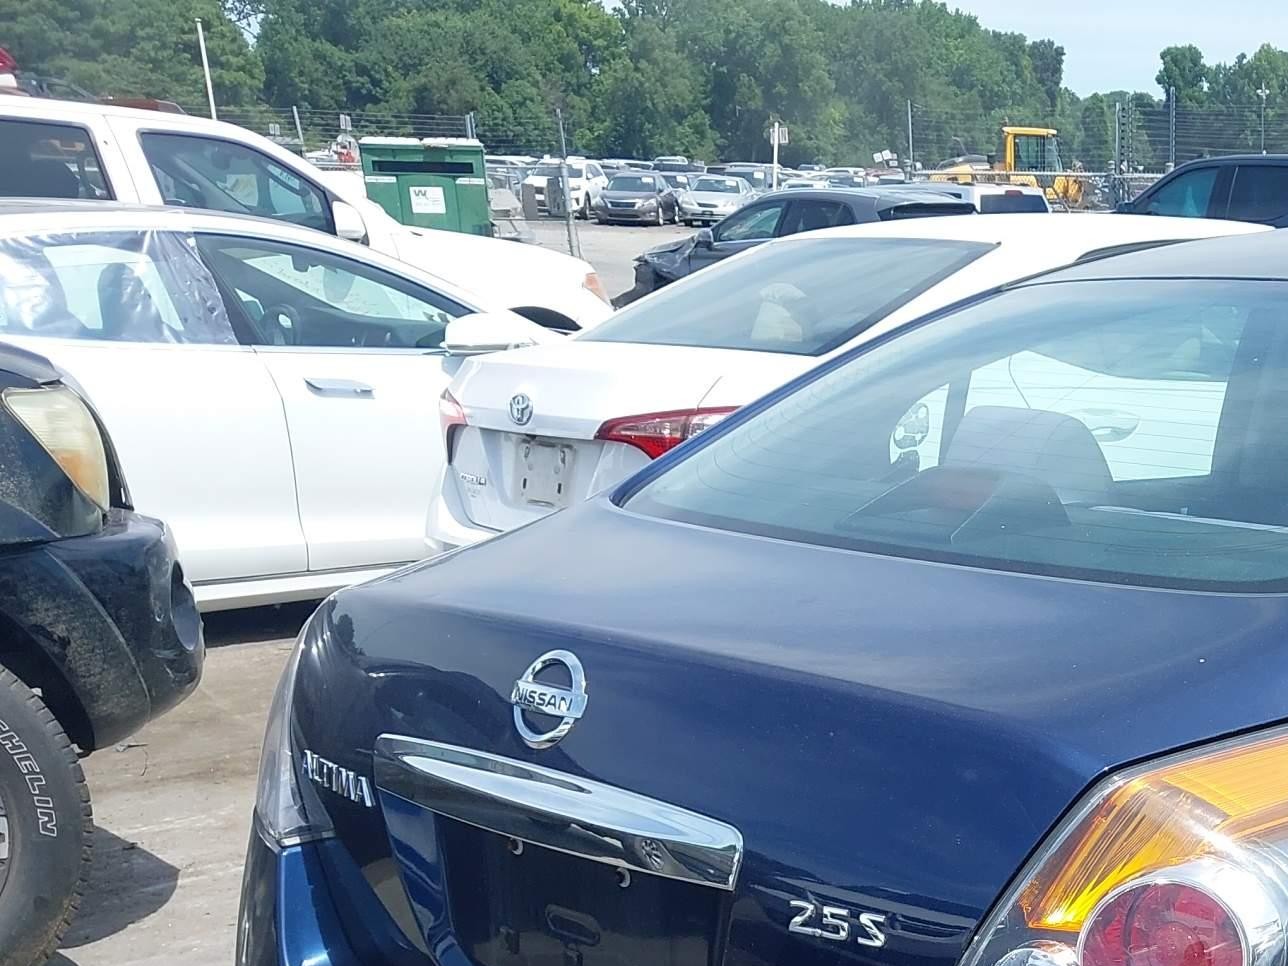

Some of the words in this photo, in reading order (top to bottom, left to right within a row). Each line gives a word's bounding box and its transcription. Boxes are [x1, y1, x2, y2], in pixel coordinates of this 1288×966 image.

[514, 686, 573, 712] NISSAN
[301, 749, 376, 807] ALTIMA
[857, 912, 887, 947] S
